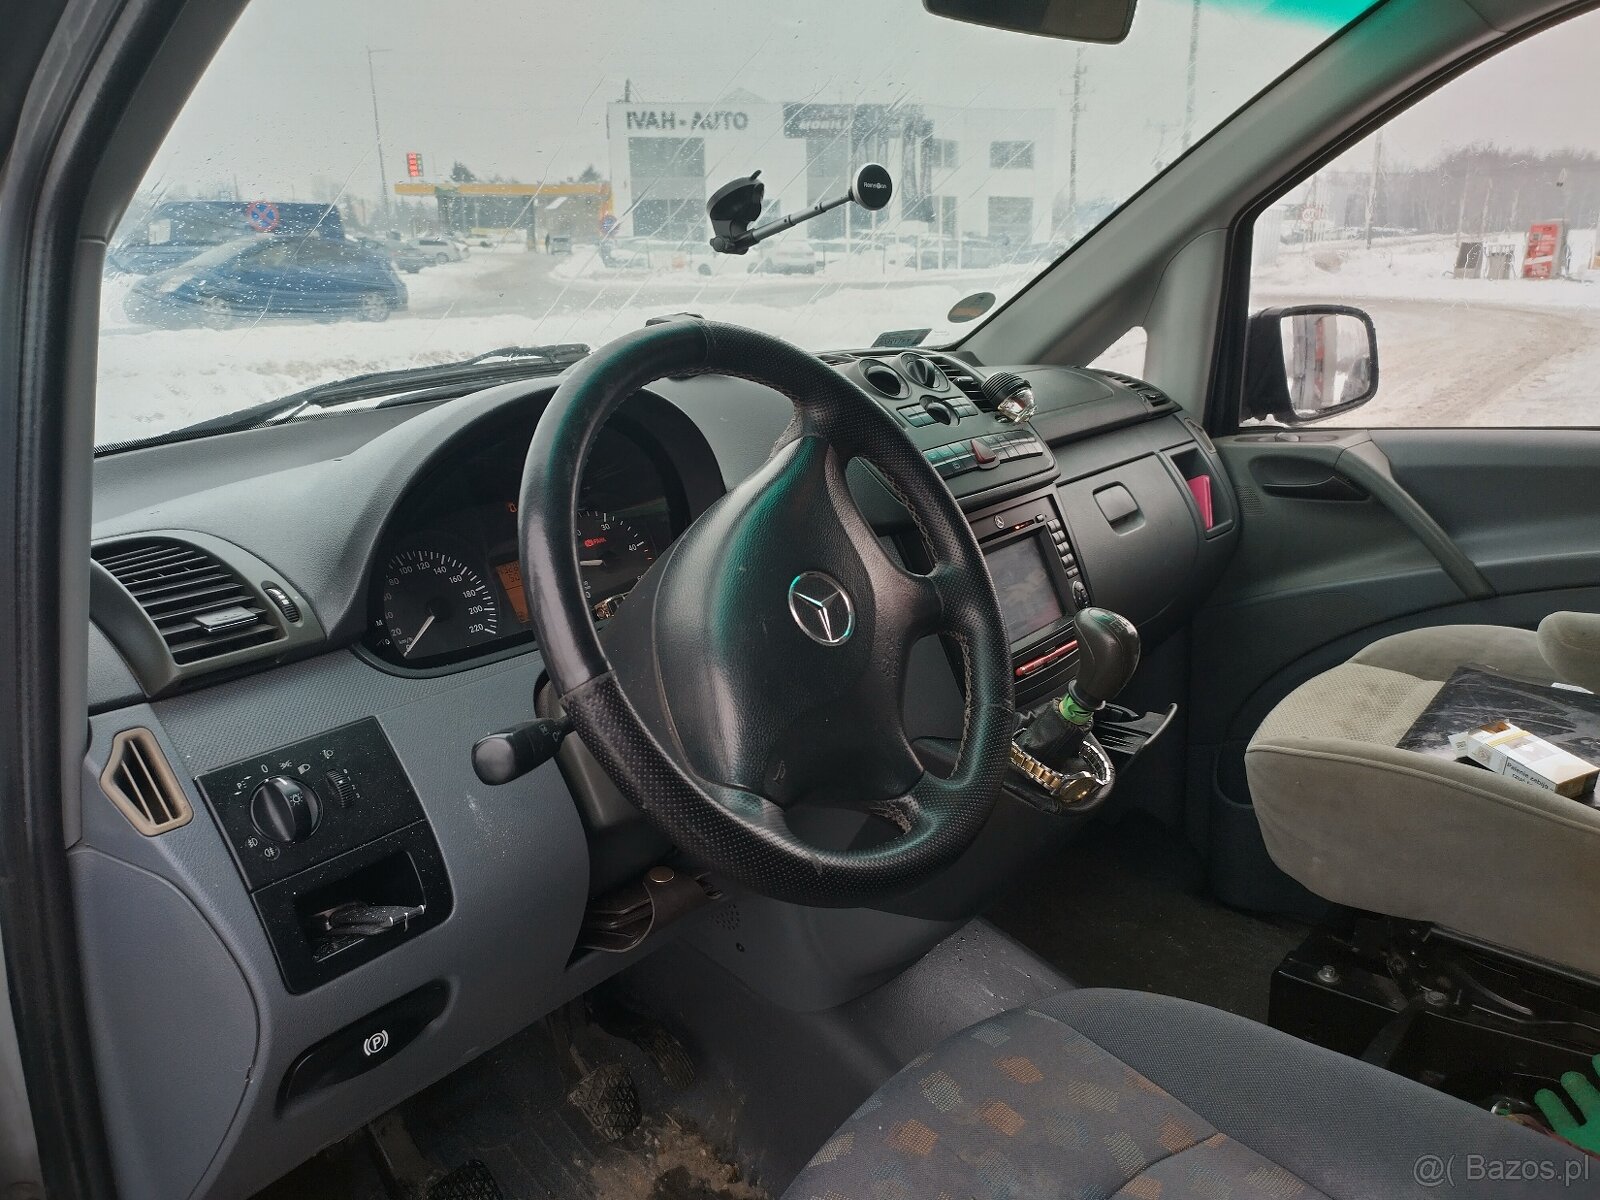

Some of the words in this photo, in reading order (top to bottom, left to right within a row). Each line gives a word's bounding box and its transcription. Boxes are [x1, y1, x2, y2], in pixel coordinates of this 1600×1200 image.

[691, 111, 748, 130] AUTO
[600, 523, 610, 531] 30
[628, 543, 637, 551] 40
[399, 566, 413, 574] 100
[416, 561, 430, 570] 120
[433, 566, 447, 575] 140
[388, 577, 400, 586] 80
[448, 574, 463, 584] 160
[462, 589, 476, 599] 180
[468, 605, 483, 615] 200
[390, 627, 402, 637] 20
[468, 623, 484, 634] 220
